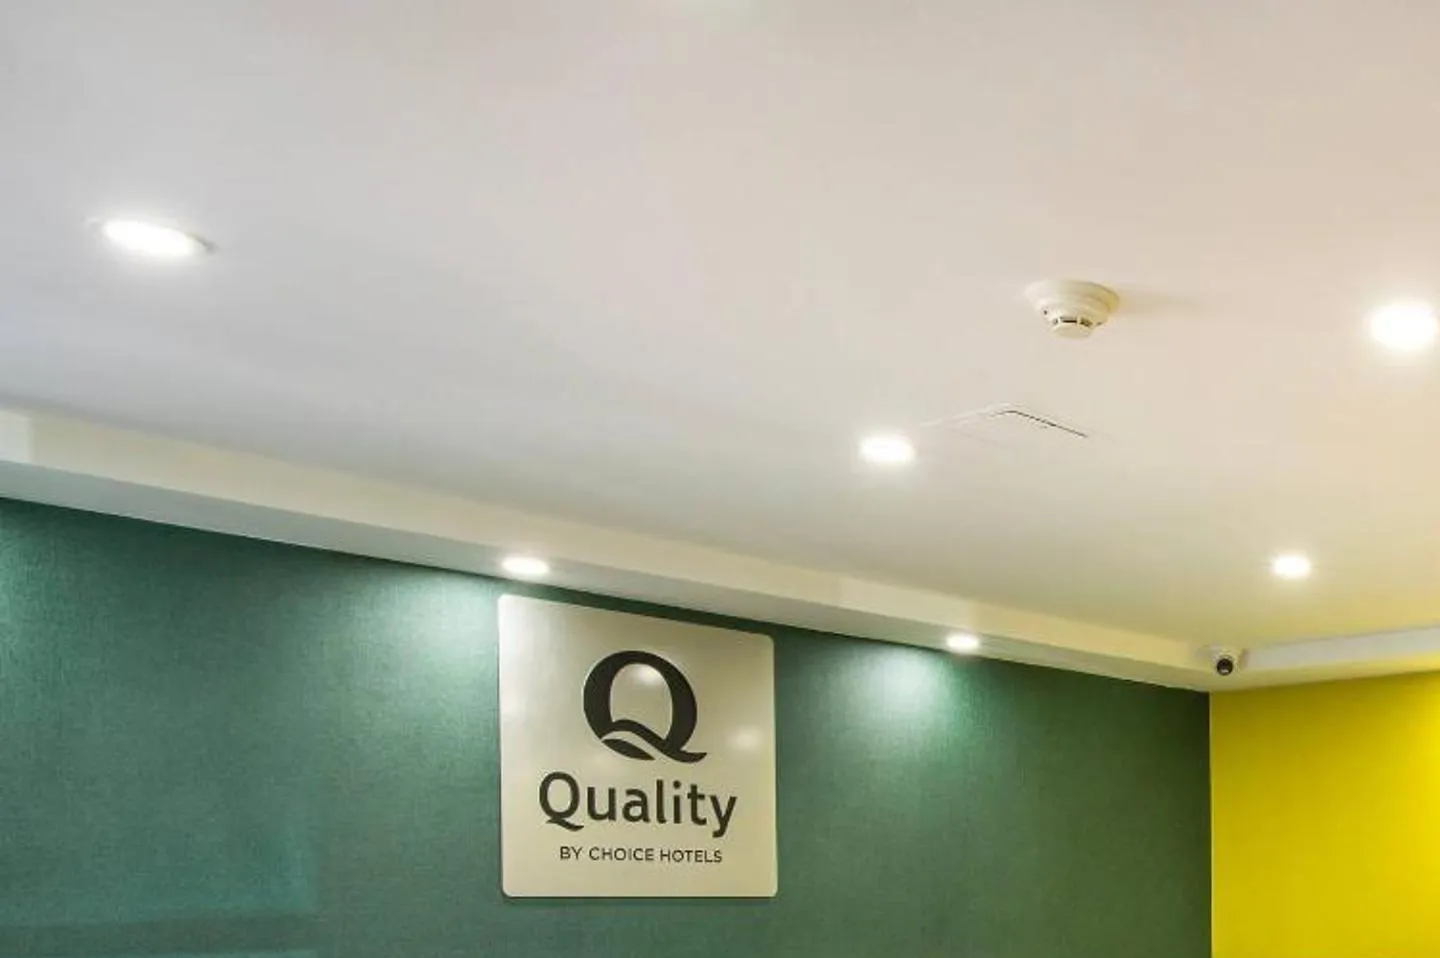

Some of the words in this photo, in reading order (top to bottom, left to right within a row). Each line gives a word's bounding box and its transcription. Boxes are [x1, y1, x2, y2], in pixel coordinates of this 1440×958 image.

[583, 650, 708, 764] Q
[538, 771, 738, 838] Quality
[559, 845, 583, 861] BY
[588, 846, 655, 862] CHOICE
[659, 848, 723, 864] HOTELS
